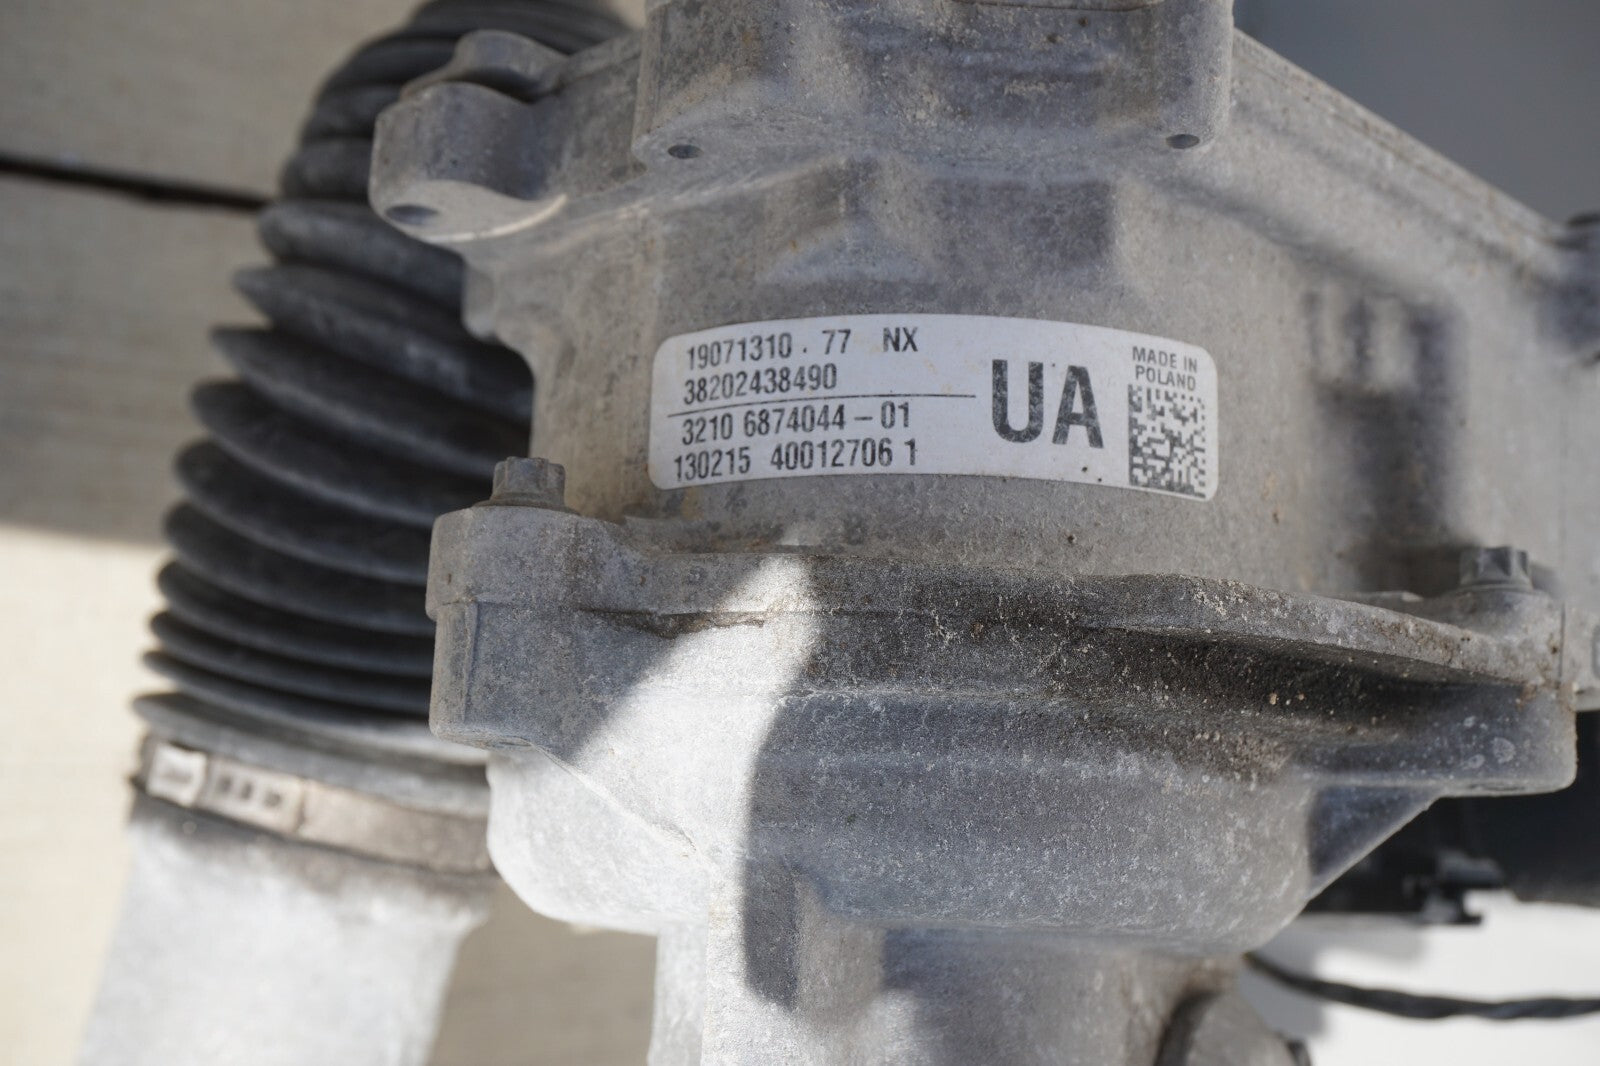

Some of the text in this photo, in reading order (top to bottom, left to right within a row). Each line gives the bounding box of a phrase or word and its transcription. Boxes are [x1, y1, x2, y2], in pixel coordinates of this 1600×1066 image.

[882, 326, 919, 353] NX
[1132, 345, 1198, 373] MADE IN
[683, 363, 837, 405] 38202438490
[1135, 364, 1197, 391] POLAND
[991, 359, 1104, 449] UA
[682, 412, 733, 446] 3210
[674, 446, 751, 483] 130215
